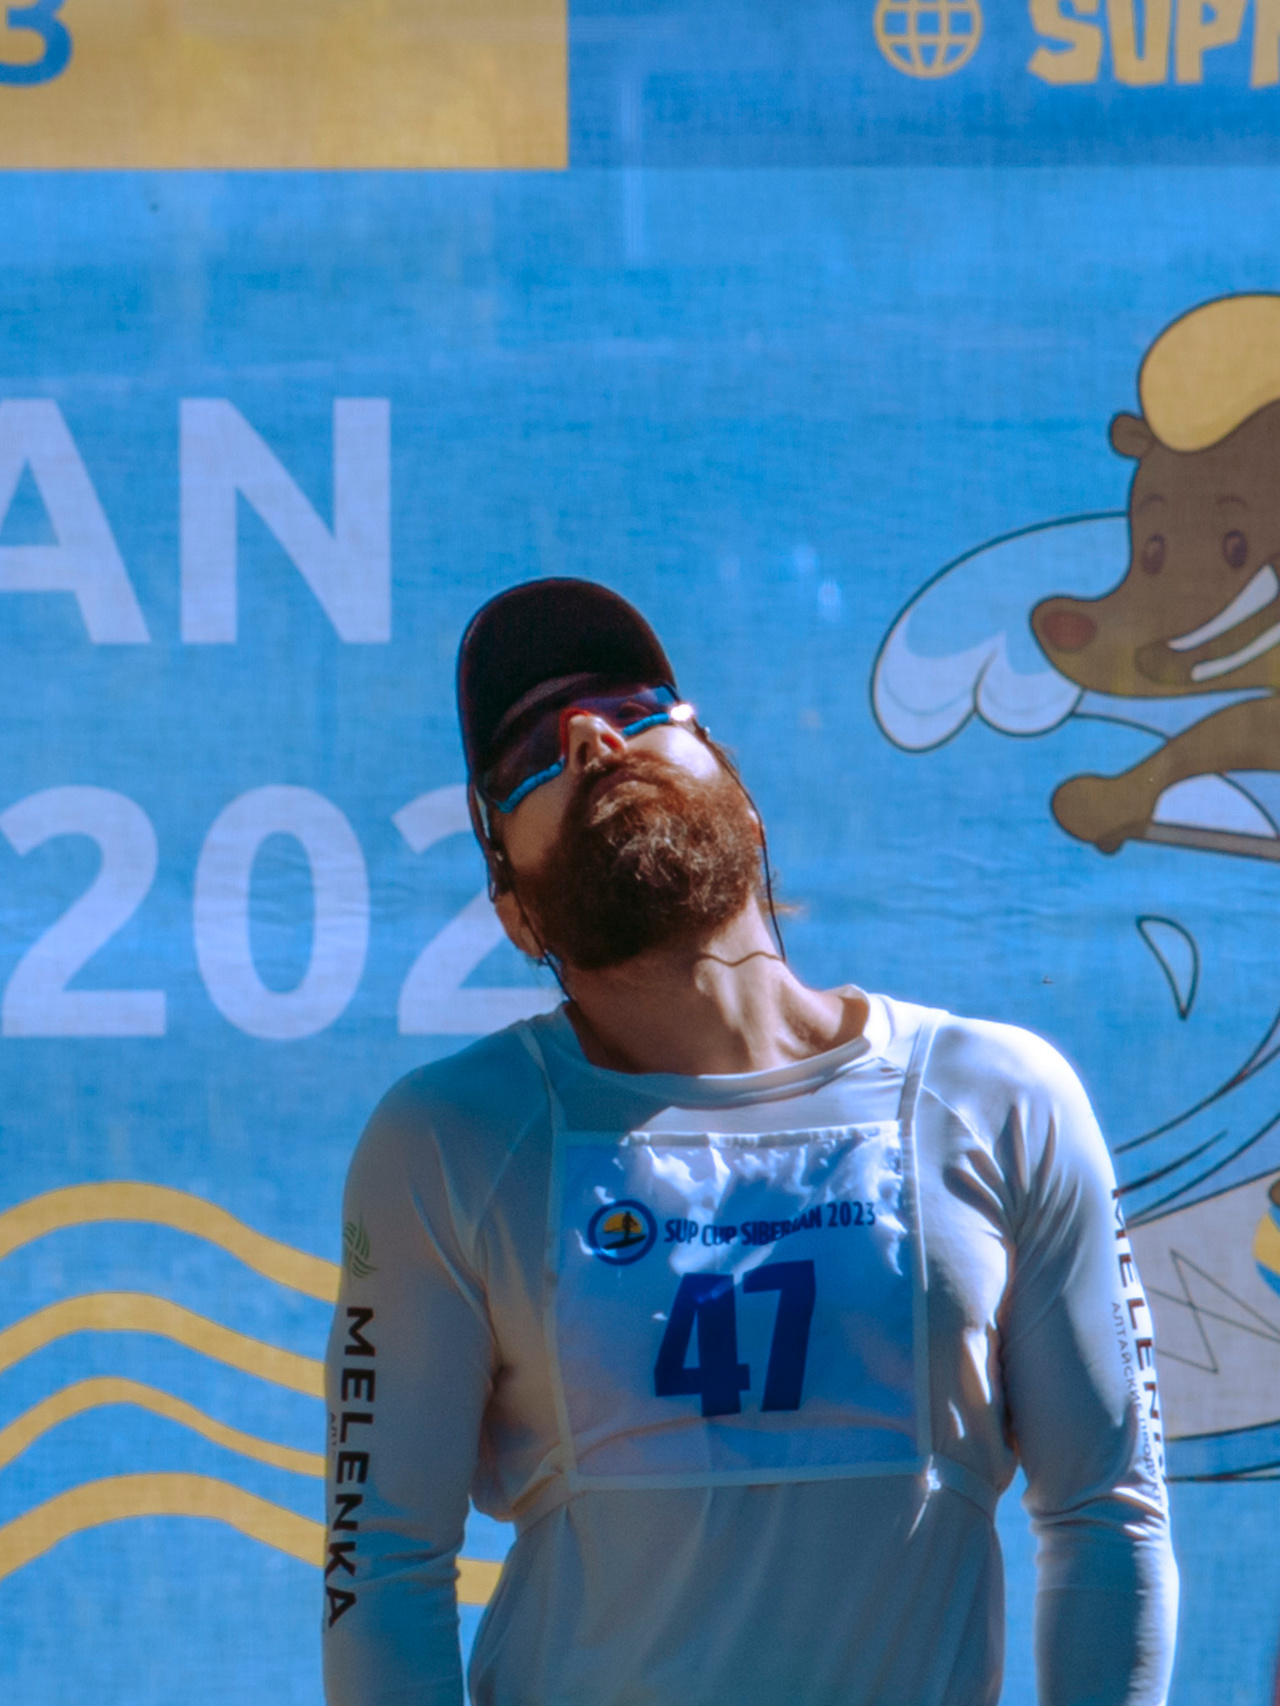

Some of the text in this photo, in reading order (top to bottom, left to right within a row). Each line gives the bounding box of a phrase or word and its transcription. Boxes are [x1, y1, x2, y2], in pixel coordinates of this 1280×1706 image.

[0, 397, 392, 644] AN
[664, 1201, 876, 1247] SUP CUP SIBERIAN 2023
[653, 1259, 816, 1417] 47
[324, 1306, 377, 1629] MELENKA
